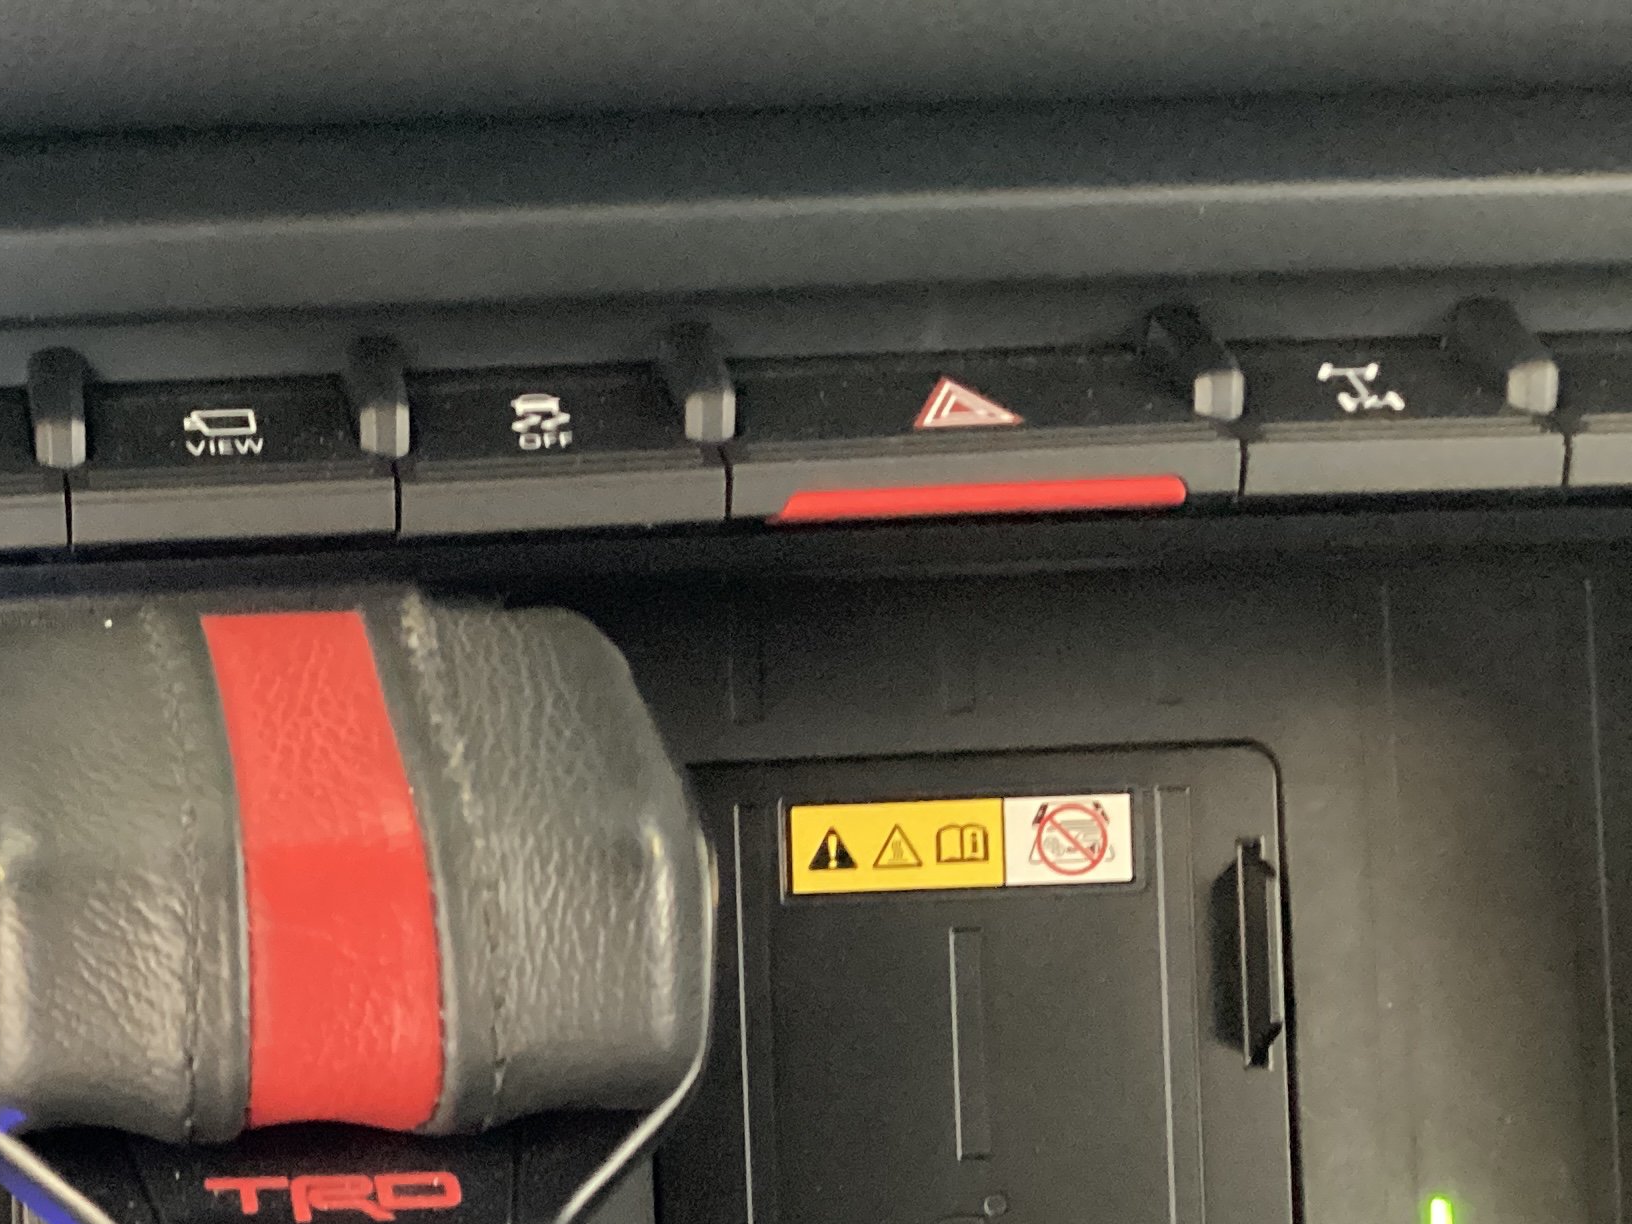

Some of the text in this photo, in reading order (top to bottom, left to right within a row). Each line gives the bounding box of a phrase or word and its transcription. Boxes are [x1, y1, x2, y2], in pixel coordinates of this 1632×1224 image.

[185, 437, 264, 457] VIEW
[518, 430, 573, 451] OFF
[203, 1171, 462, 1224] TRD
